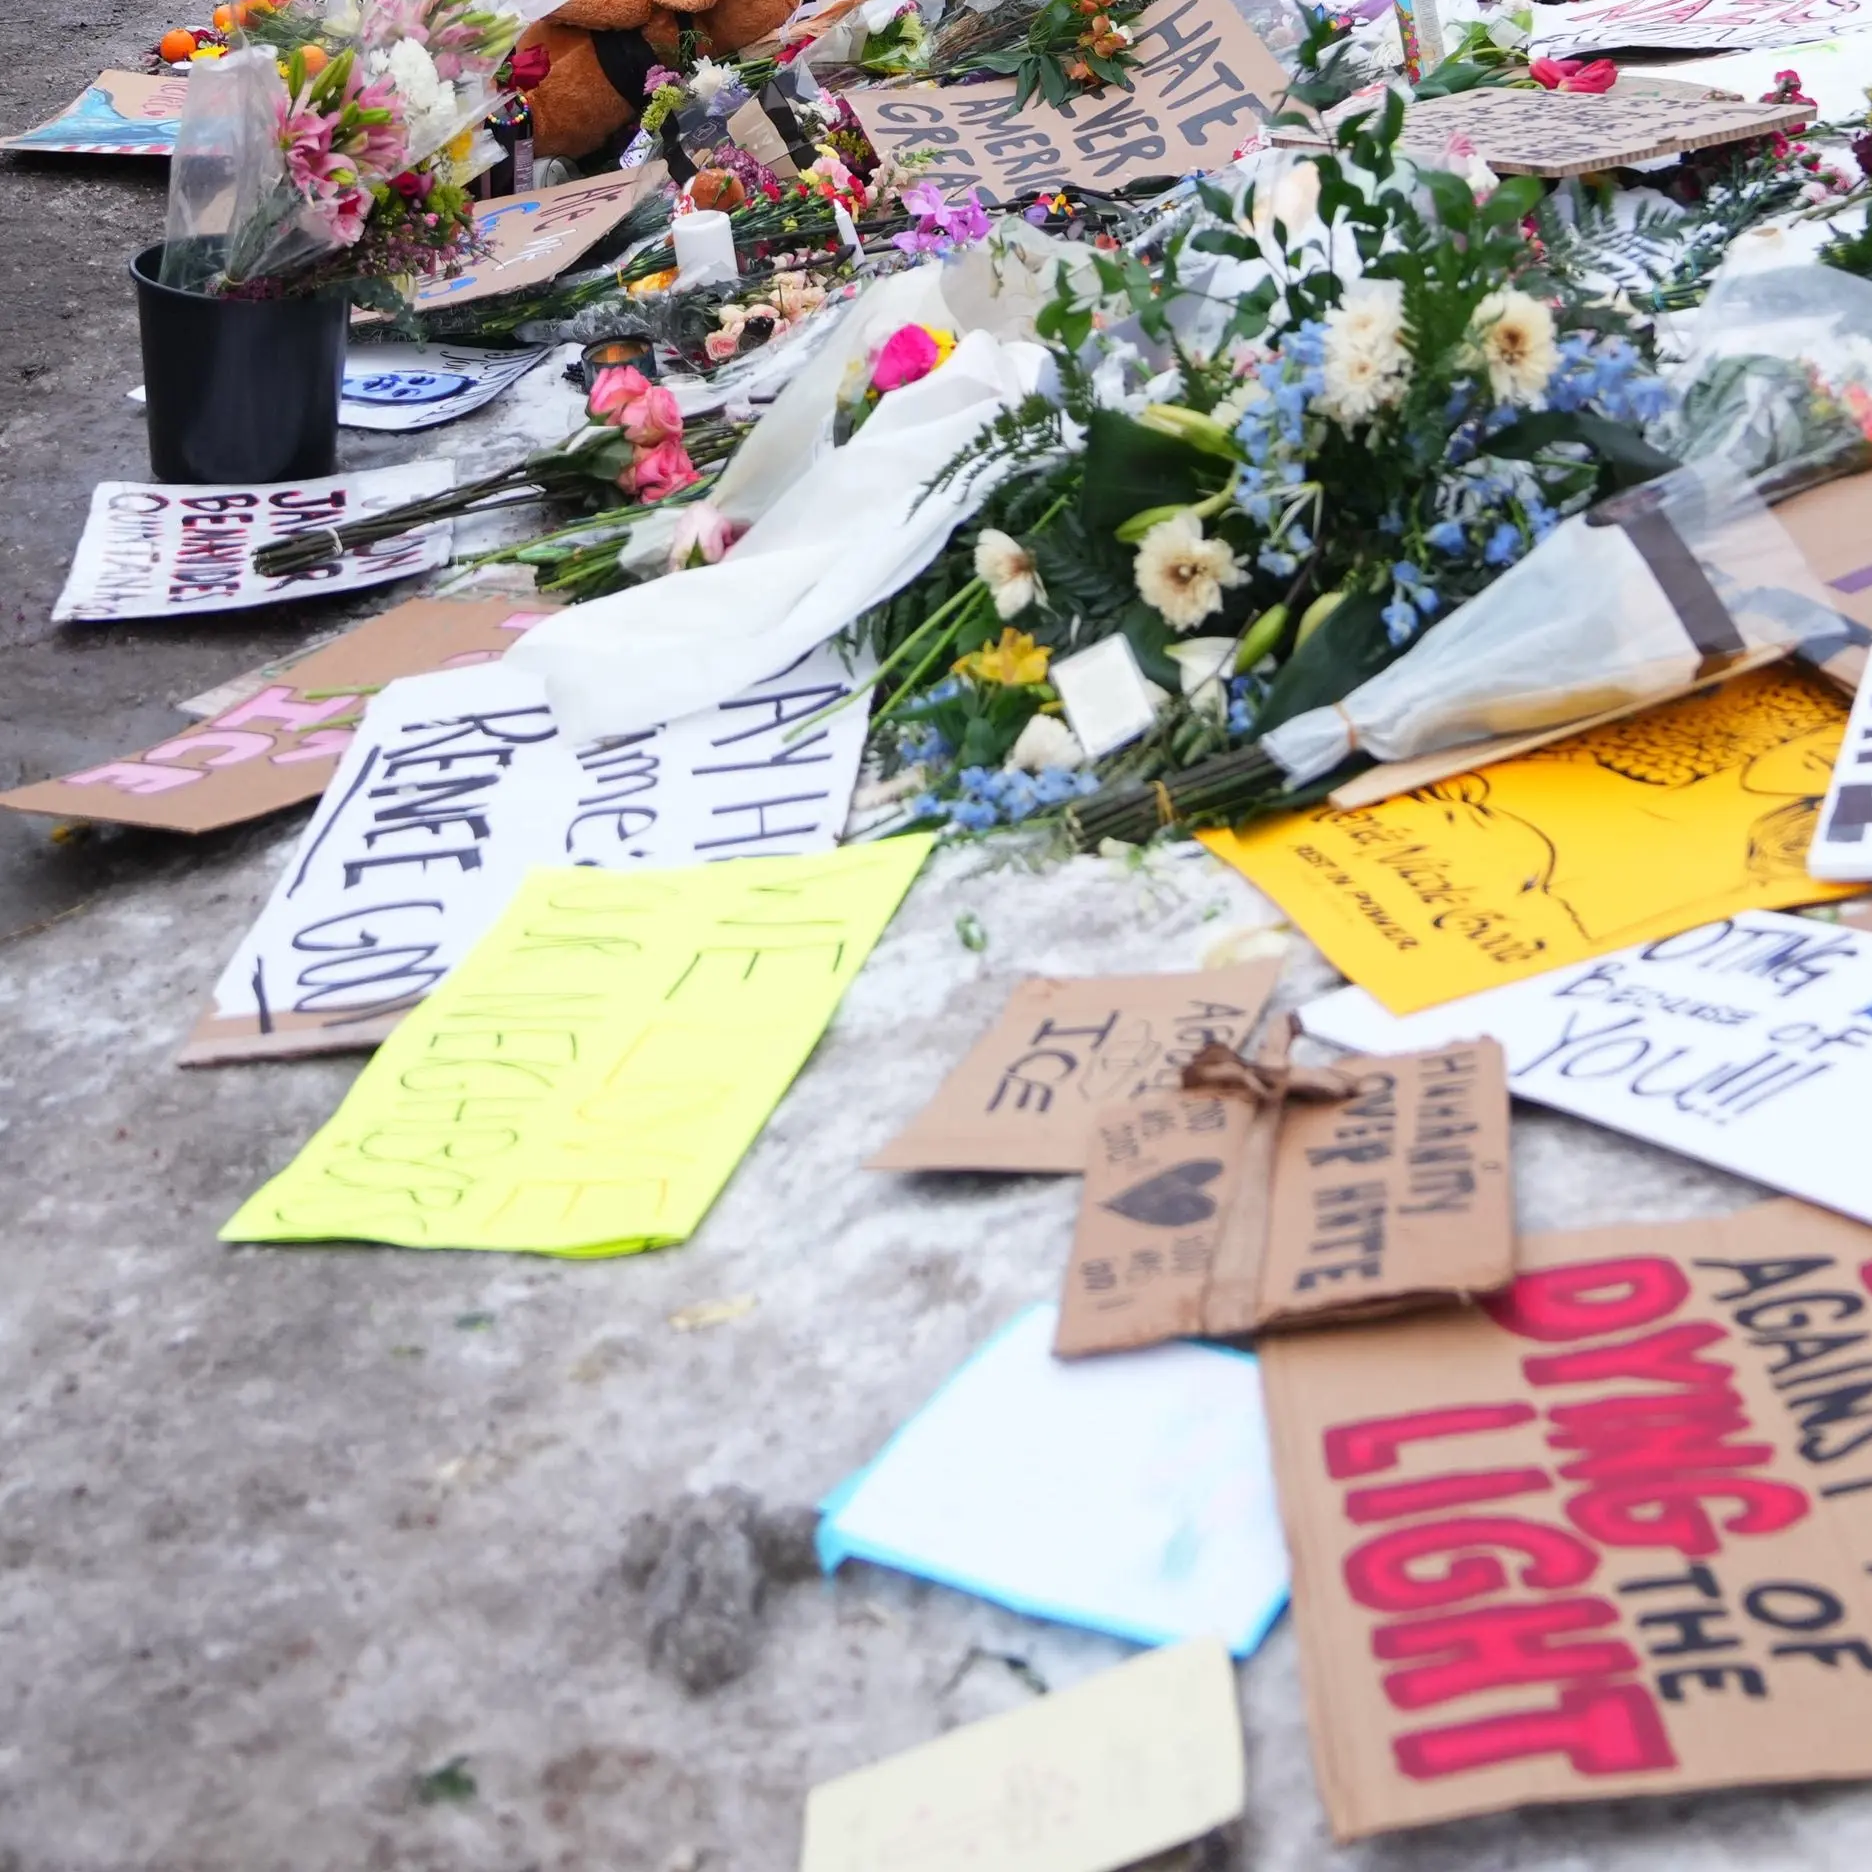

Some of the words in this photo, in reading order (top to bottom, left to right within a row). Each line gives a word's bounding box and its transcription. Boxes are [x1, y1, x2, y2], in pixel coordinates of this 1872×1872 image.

[167, 492, 261, 604] BENAVIDES
[342, 702, 560, 892] RENEE
[987, 1009, 1120, 1116] ICE
[1503, 1012, 1839, 1127] YOU!!!
[1482, 1254, 1811, 1560] DYING
[1323, 1401, 1678, 1780] LIGHT
[1619, 1562, 1767, 1706] THE
